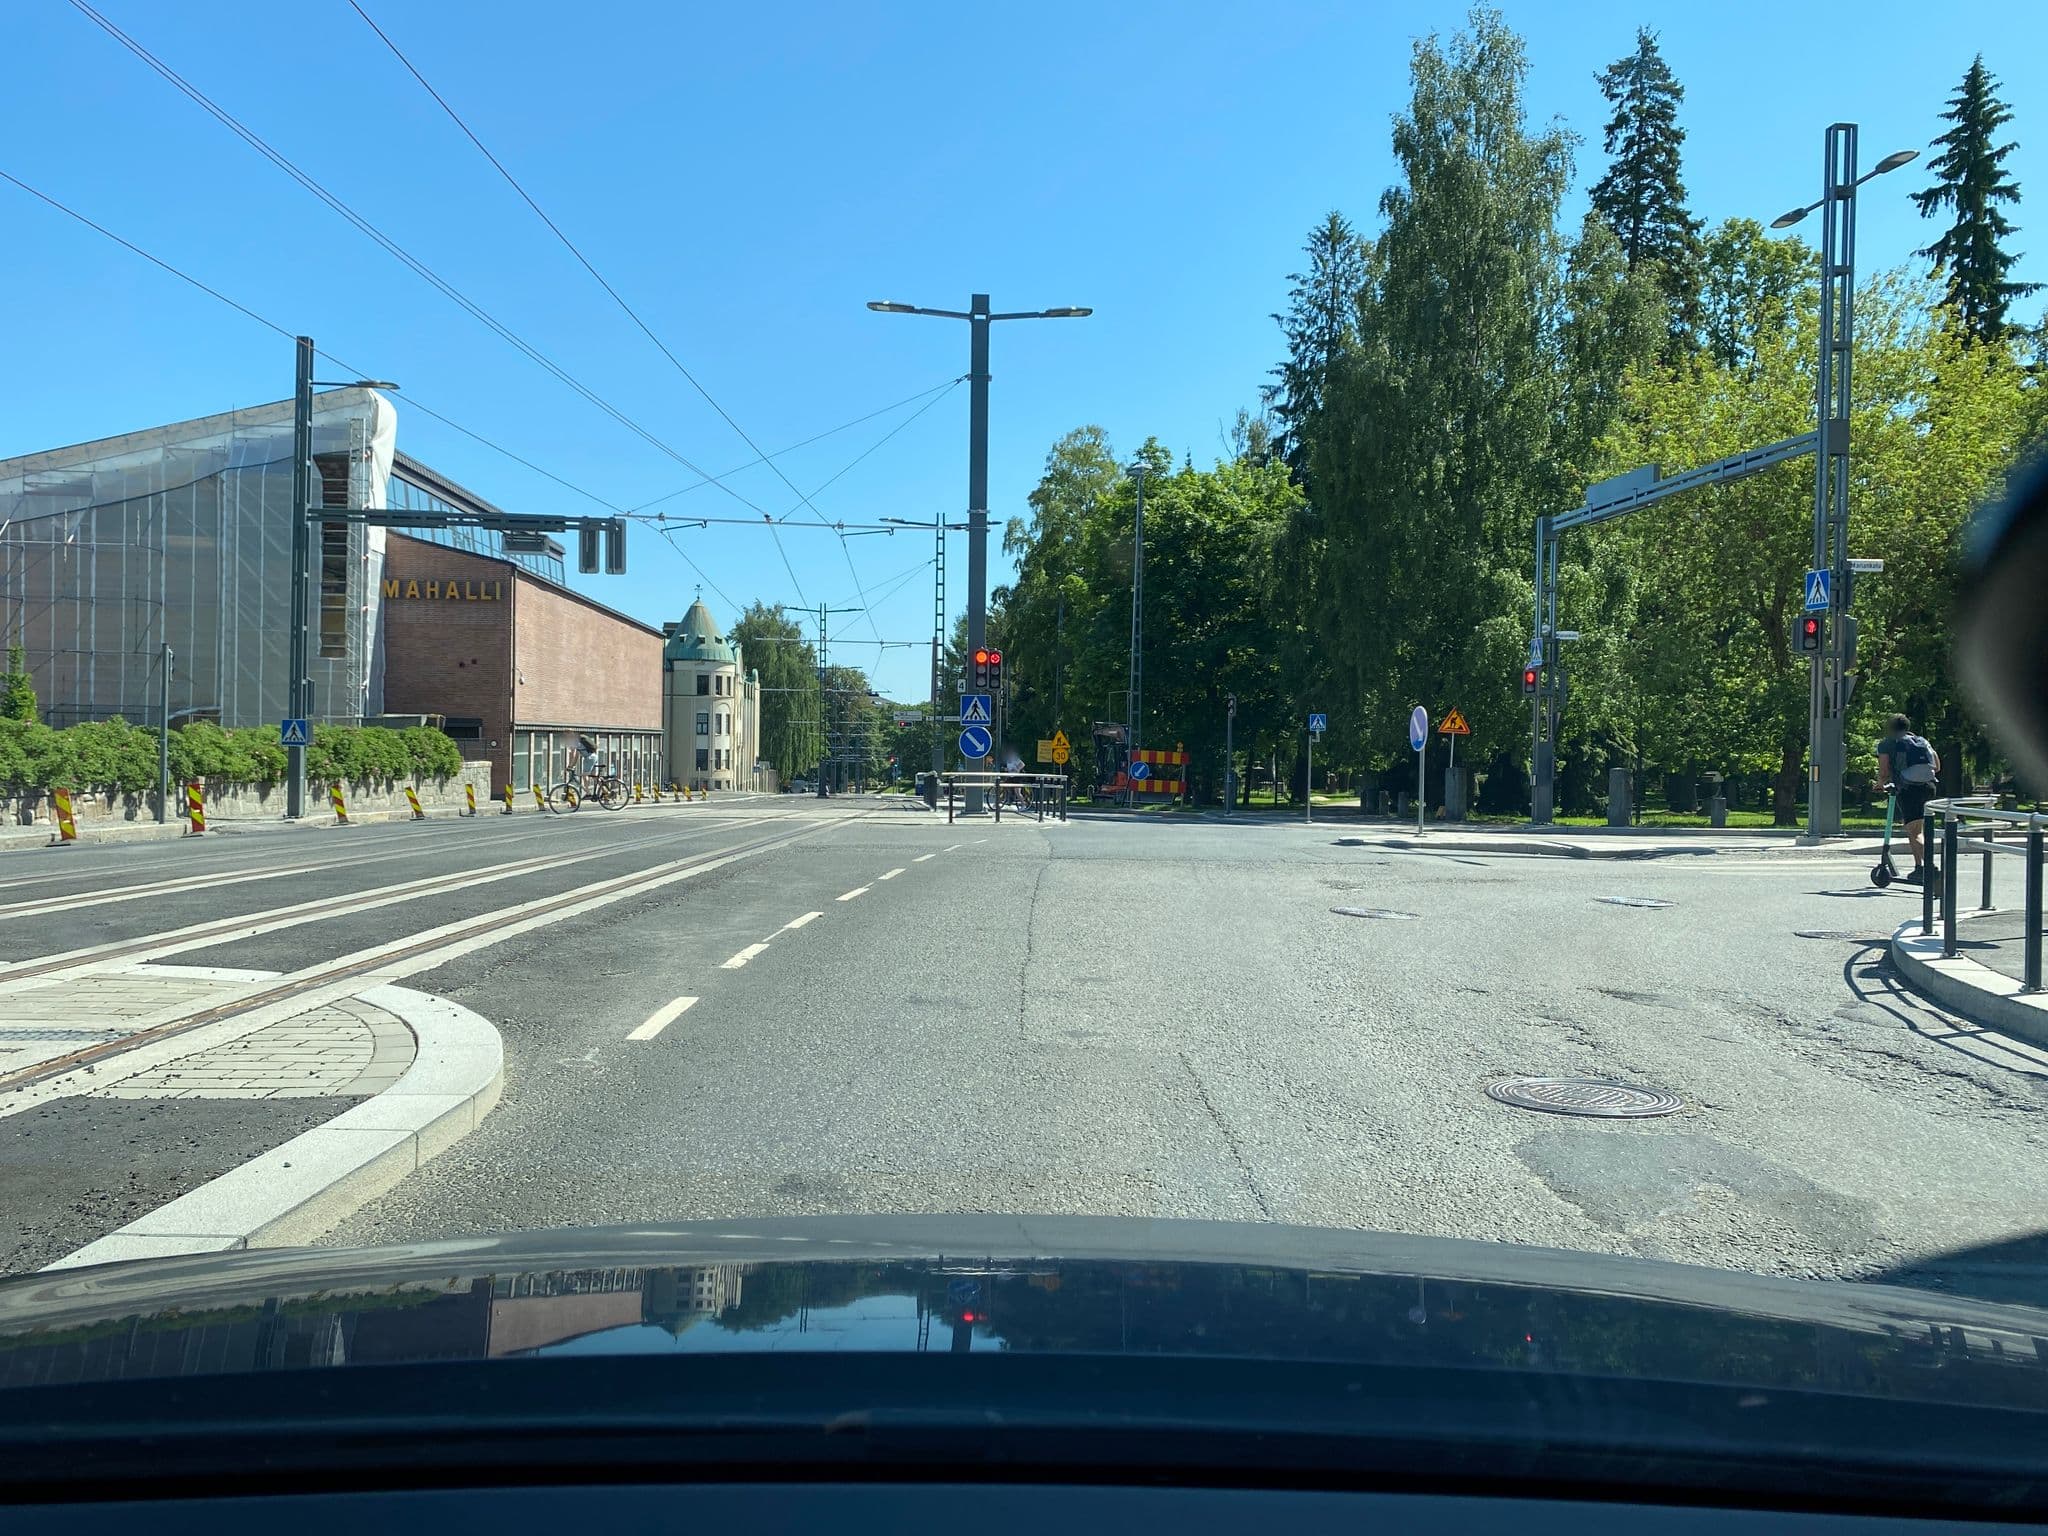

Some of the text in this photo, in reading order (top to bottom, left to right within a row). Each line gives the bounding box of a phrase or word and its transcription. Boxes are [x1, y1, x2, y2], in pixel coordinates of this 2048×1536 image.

[383, 579, 501, 600] MAHALLI
[958, 682, 965, 690] 4
[1055, 752, 1066, 760] 30
